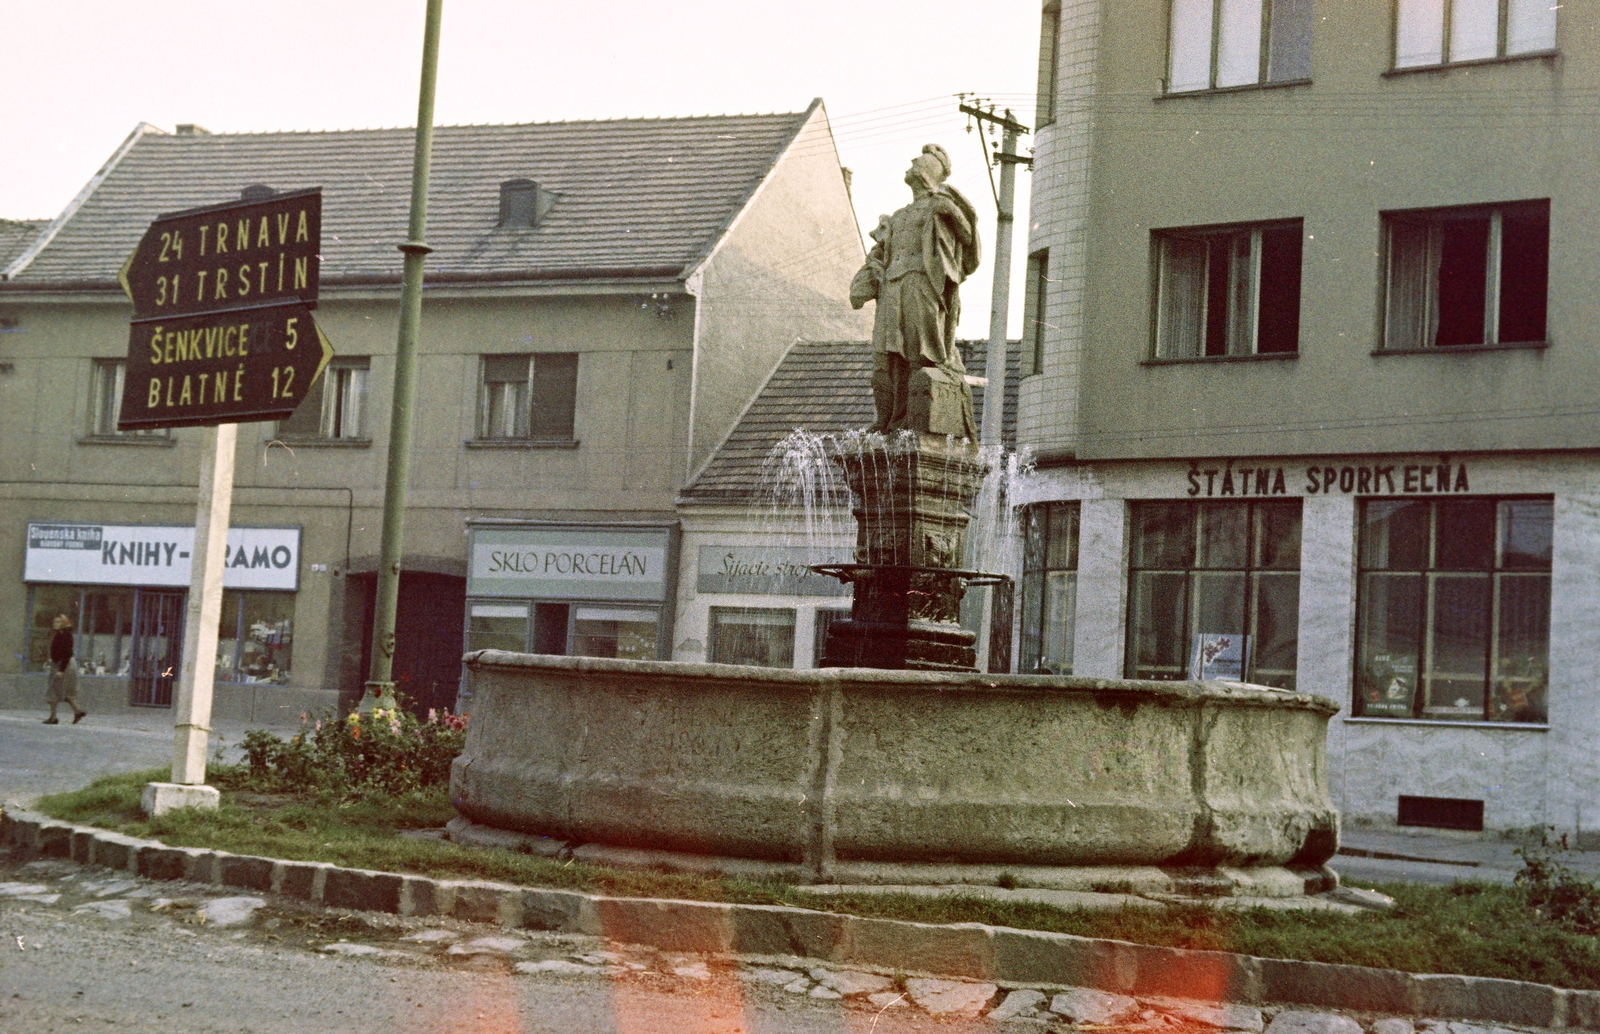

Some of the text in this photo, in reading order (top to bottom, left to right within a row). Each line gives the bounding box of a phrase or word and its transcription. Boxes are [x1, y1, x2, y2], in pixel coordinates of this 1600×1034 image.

[159, 211, 308, 262] 24 TRNAVA
[155, 253, 307, 306] 31 TRSTÍN
[151, 317, 298, 363] ŠENKVICE 5
[148, 363, 295, 408] BLATNÉ 12
[1187, 457, 1287, 497] ŠTÁTNA
[76, 528, 102, 541] kniha
[489, 551, 647, 576] SKLO PORCELÁN
